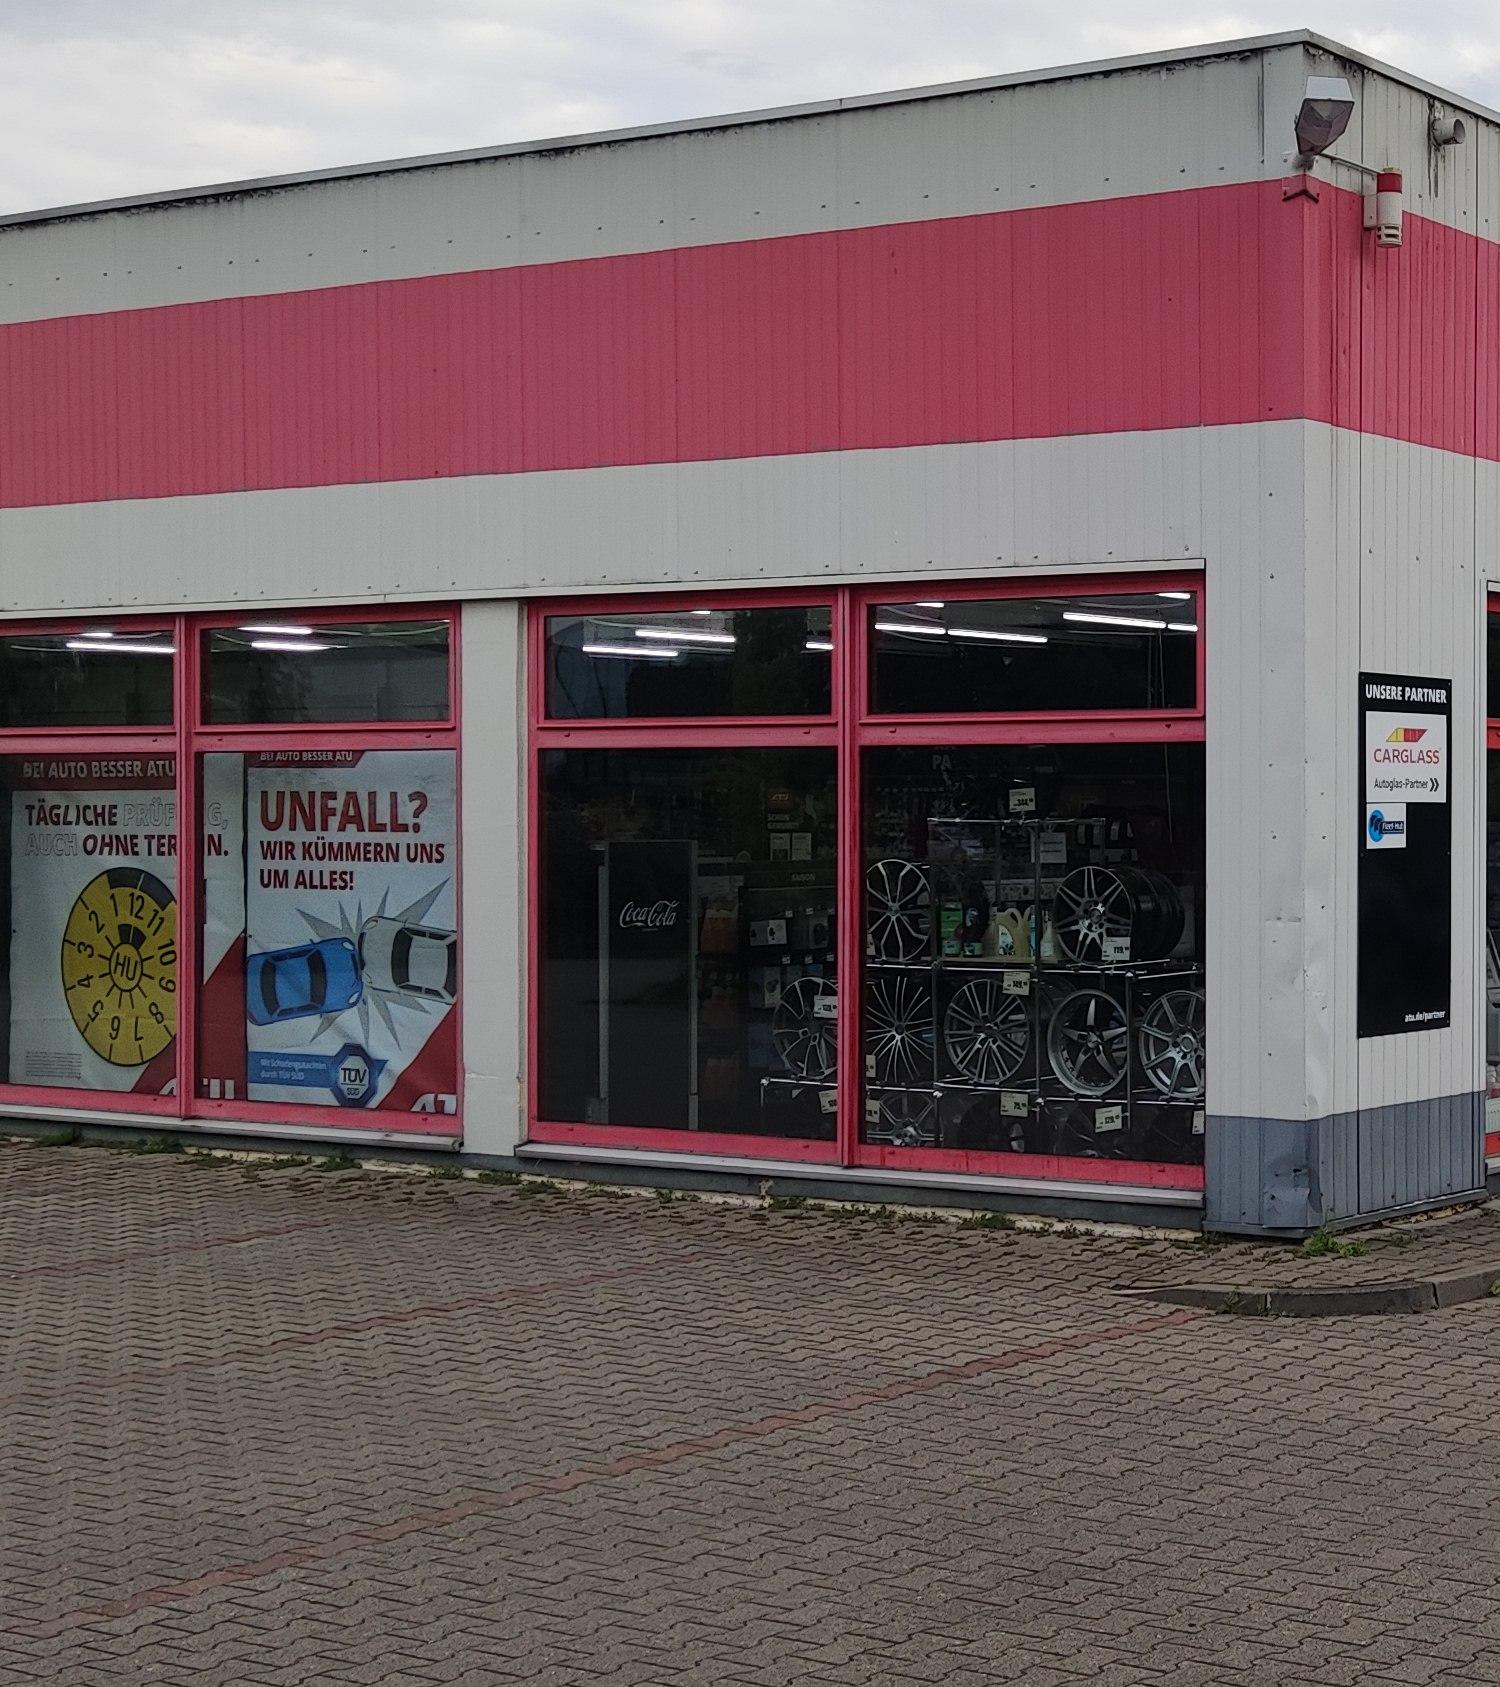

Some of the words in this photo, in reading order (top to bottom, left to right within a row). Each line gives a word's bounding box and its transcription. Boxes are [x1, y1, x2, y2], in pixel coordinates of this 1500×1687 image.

[1365, 683, 1403, 701] UNSERE
[1404, 687, 1447, 704] PARTNER
[260, 751, 274, 762] BEI
[276, 751, 300, 762] AUTO
[302, 751, 333, 762] BESSER
[335, 752, 353, 762] ATU
[1373, 748, 1440, 765] CARGLASS
[23, 761, 44, 778] BEI
[48, 761, 86, 778] AUTO
[91, 760, 143, 777] BESSER
[147, 759, 175, 777] ATU
[1374, 777, 1429, 792] Autoglas-Partner
[25, 798, 118, 826] TÄGLICHE
[122, 798, 228, 829] PRÜFG,
[260, 790, 428, 834] UNFALL?
[82, 834, 139, 857] OHNE
[144, 834, 229, 857] TERN.
[260, 840, 297, 861] WIR
[301, 836, 400, 863] KÜMMERN
[406, 842, 446, 864] UNS
[260, 868, 289, 889] UM
[294, 869, 354, 891] ALLES!
[129, 892, 145, 921] 12
[88, 909, 106, 934] 2
[113, 952, 138, 982] HU
[340, 1066, 367, 1083] TÜV
